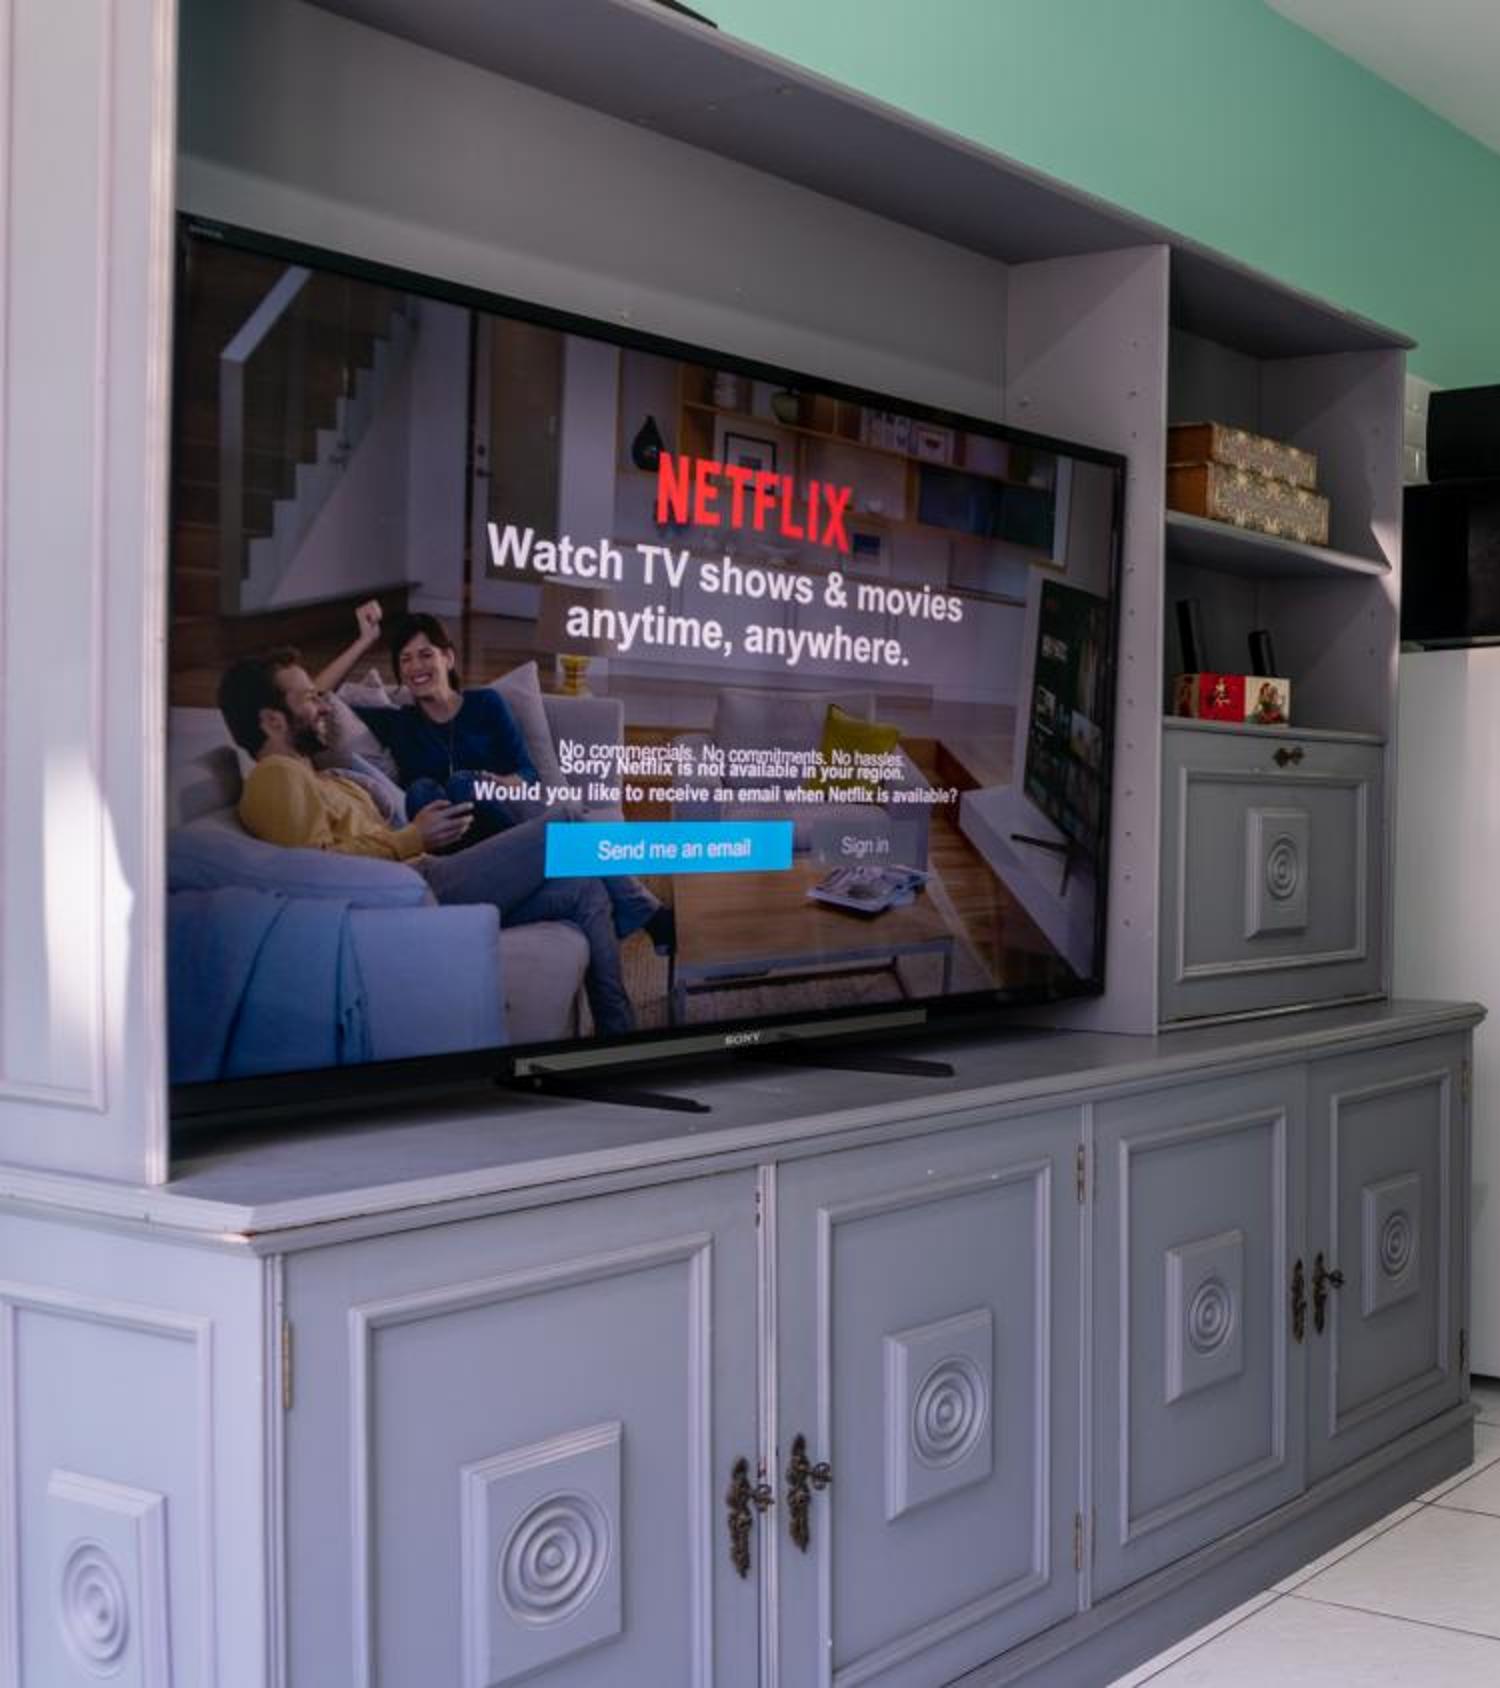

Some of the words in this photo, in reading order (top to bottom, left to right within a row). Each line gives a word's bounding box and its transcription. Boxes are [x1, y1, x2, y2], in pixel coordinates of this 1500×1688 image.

[656, 451, 852, 553] NETFLIX
[487, 522, 623, 581] Watch
[637, 544, 689, 588] TV
[700, 556, 814, 605] shows
[825, 571, 848, 608] &
[858, 583, 963, 622] movies
[566, 604, 732, 656] anytime,
[745, 624, 909, 667] anywhere.
[559, 739, 585, 760] No
[589, 743, 697, 762] commercials.
[703, 744, 725, 763] No
[728, 747, 827, 767] commitments.
[831, 750, 851, 766] No
[560, 757, 611, 778] Sorry
[616, 758, 673, 776] Netflix
[677, 759, 693, 777] is
[698, 760, 725, 777] not
[729, 762, 799, 779] available
[803, 763, 817, 779] in
[820, 766, 852, 783] your
[857, 766, 905, 784] region.
[473, 780, 540, 801] Would
[545, 785, 582, 806] you
[588, 783, 620, 802] like
[625, 783, 644, 802] to
[649, 783, 709, 802] receive
[713, 787, 734, 802] an
[737, 785, 780, 803] email
[784, 786, 824, 804] when
[828, 786, 873, 804] Netflix
[877, 786, 889, 804] is
[892, 787, 959, 805] available?
[597, 839, 645, 861] Send
[649, 843, 677, 860] me
[681, 842, 703, 860] an
[706, 839, 752, 859] email
[840, 835, 873, 860] Sign
[876, 837, 890, 854] in
[725, 1031, 760, 1046] SONY
